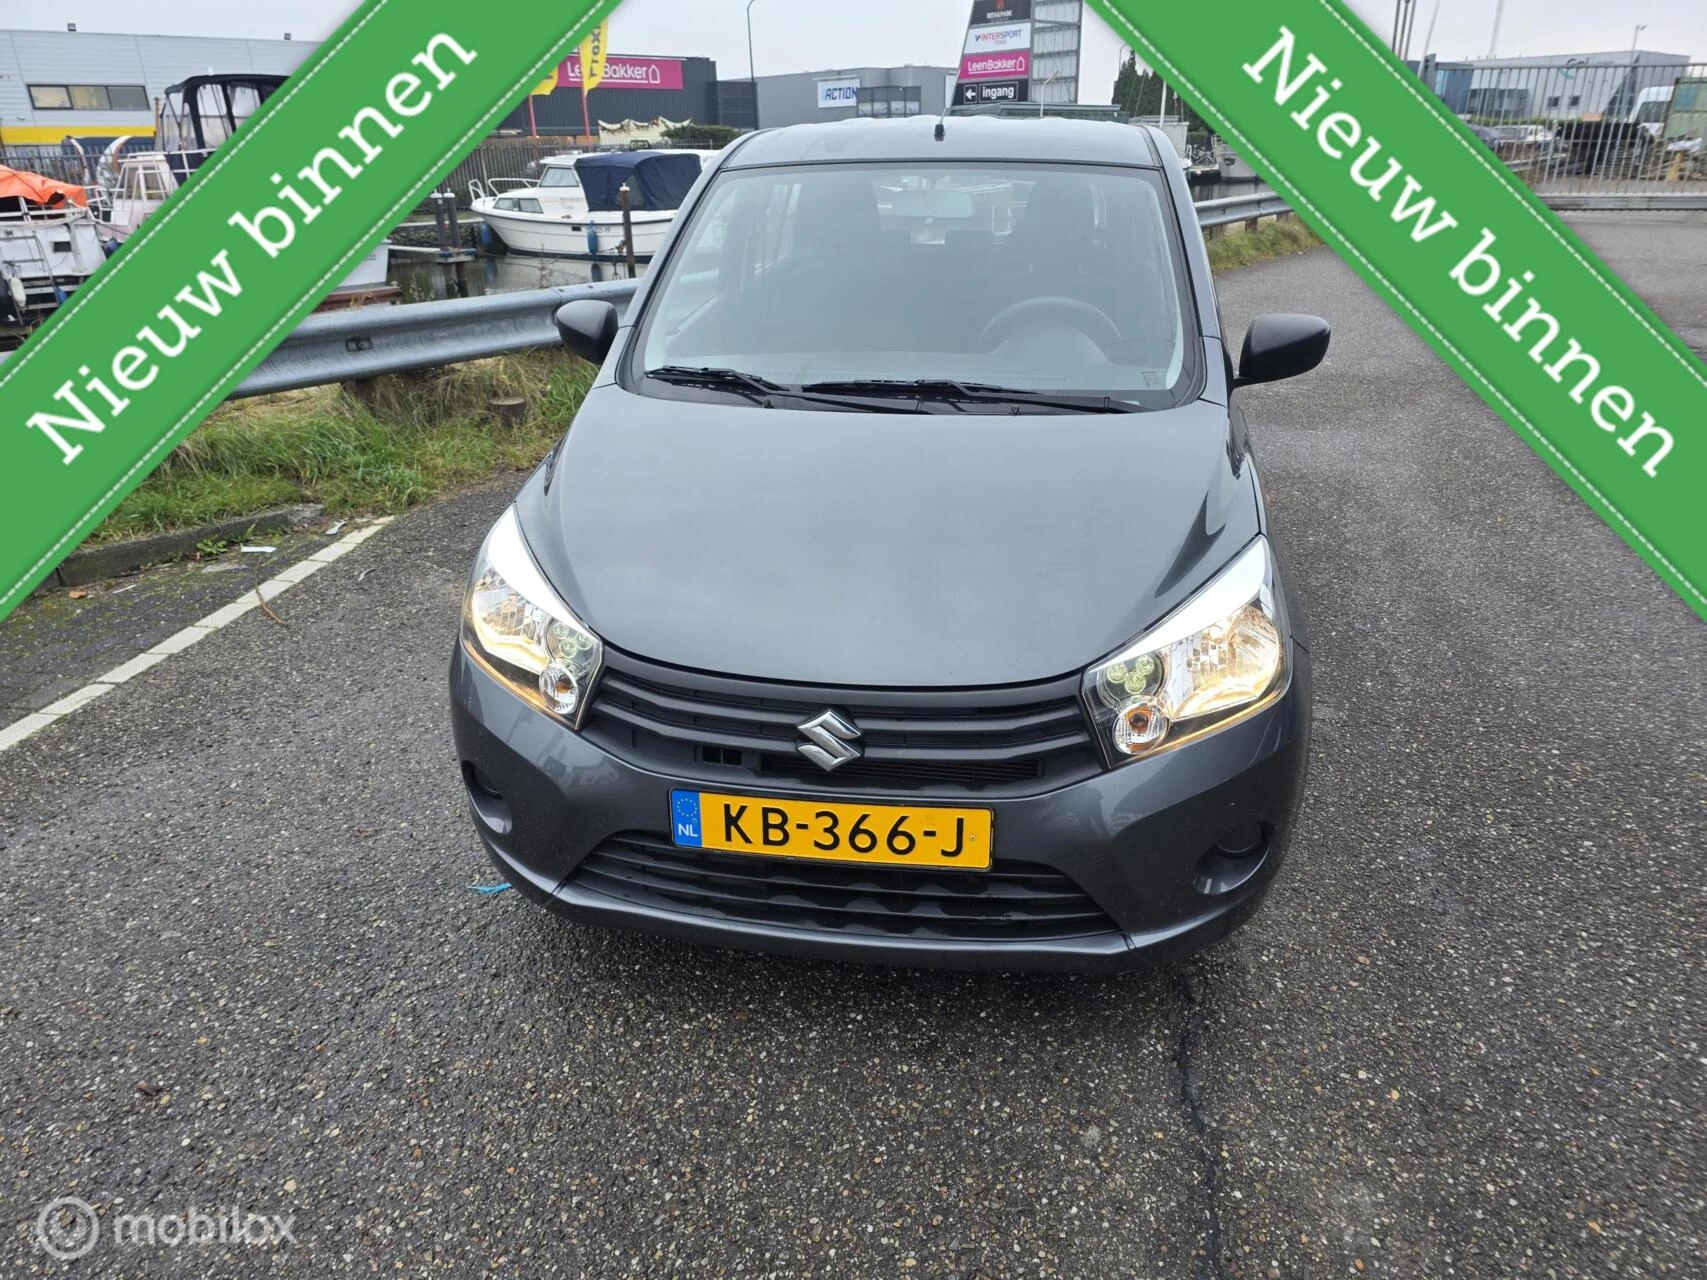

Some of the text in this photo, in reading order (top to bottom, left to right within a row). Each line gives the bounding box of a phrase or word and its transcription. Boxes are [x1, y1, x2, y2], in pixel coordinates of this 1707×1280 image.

[980, 29, 1022, 41] INTERSPORT
[565, 60, 648, 79] LeBakker
[967, 58, 1017, 72] LeenBakker
[825, 86, 857, 101] ACTION
[981, 86, 1015, 99] ingang
[678, 802, 966, 858] NL KB-366-J
